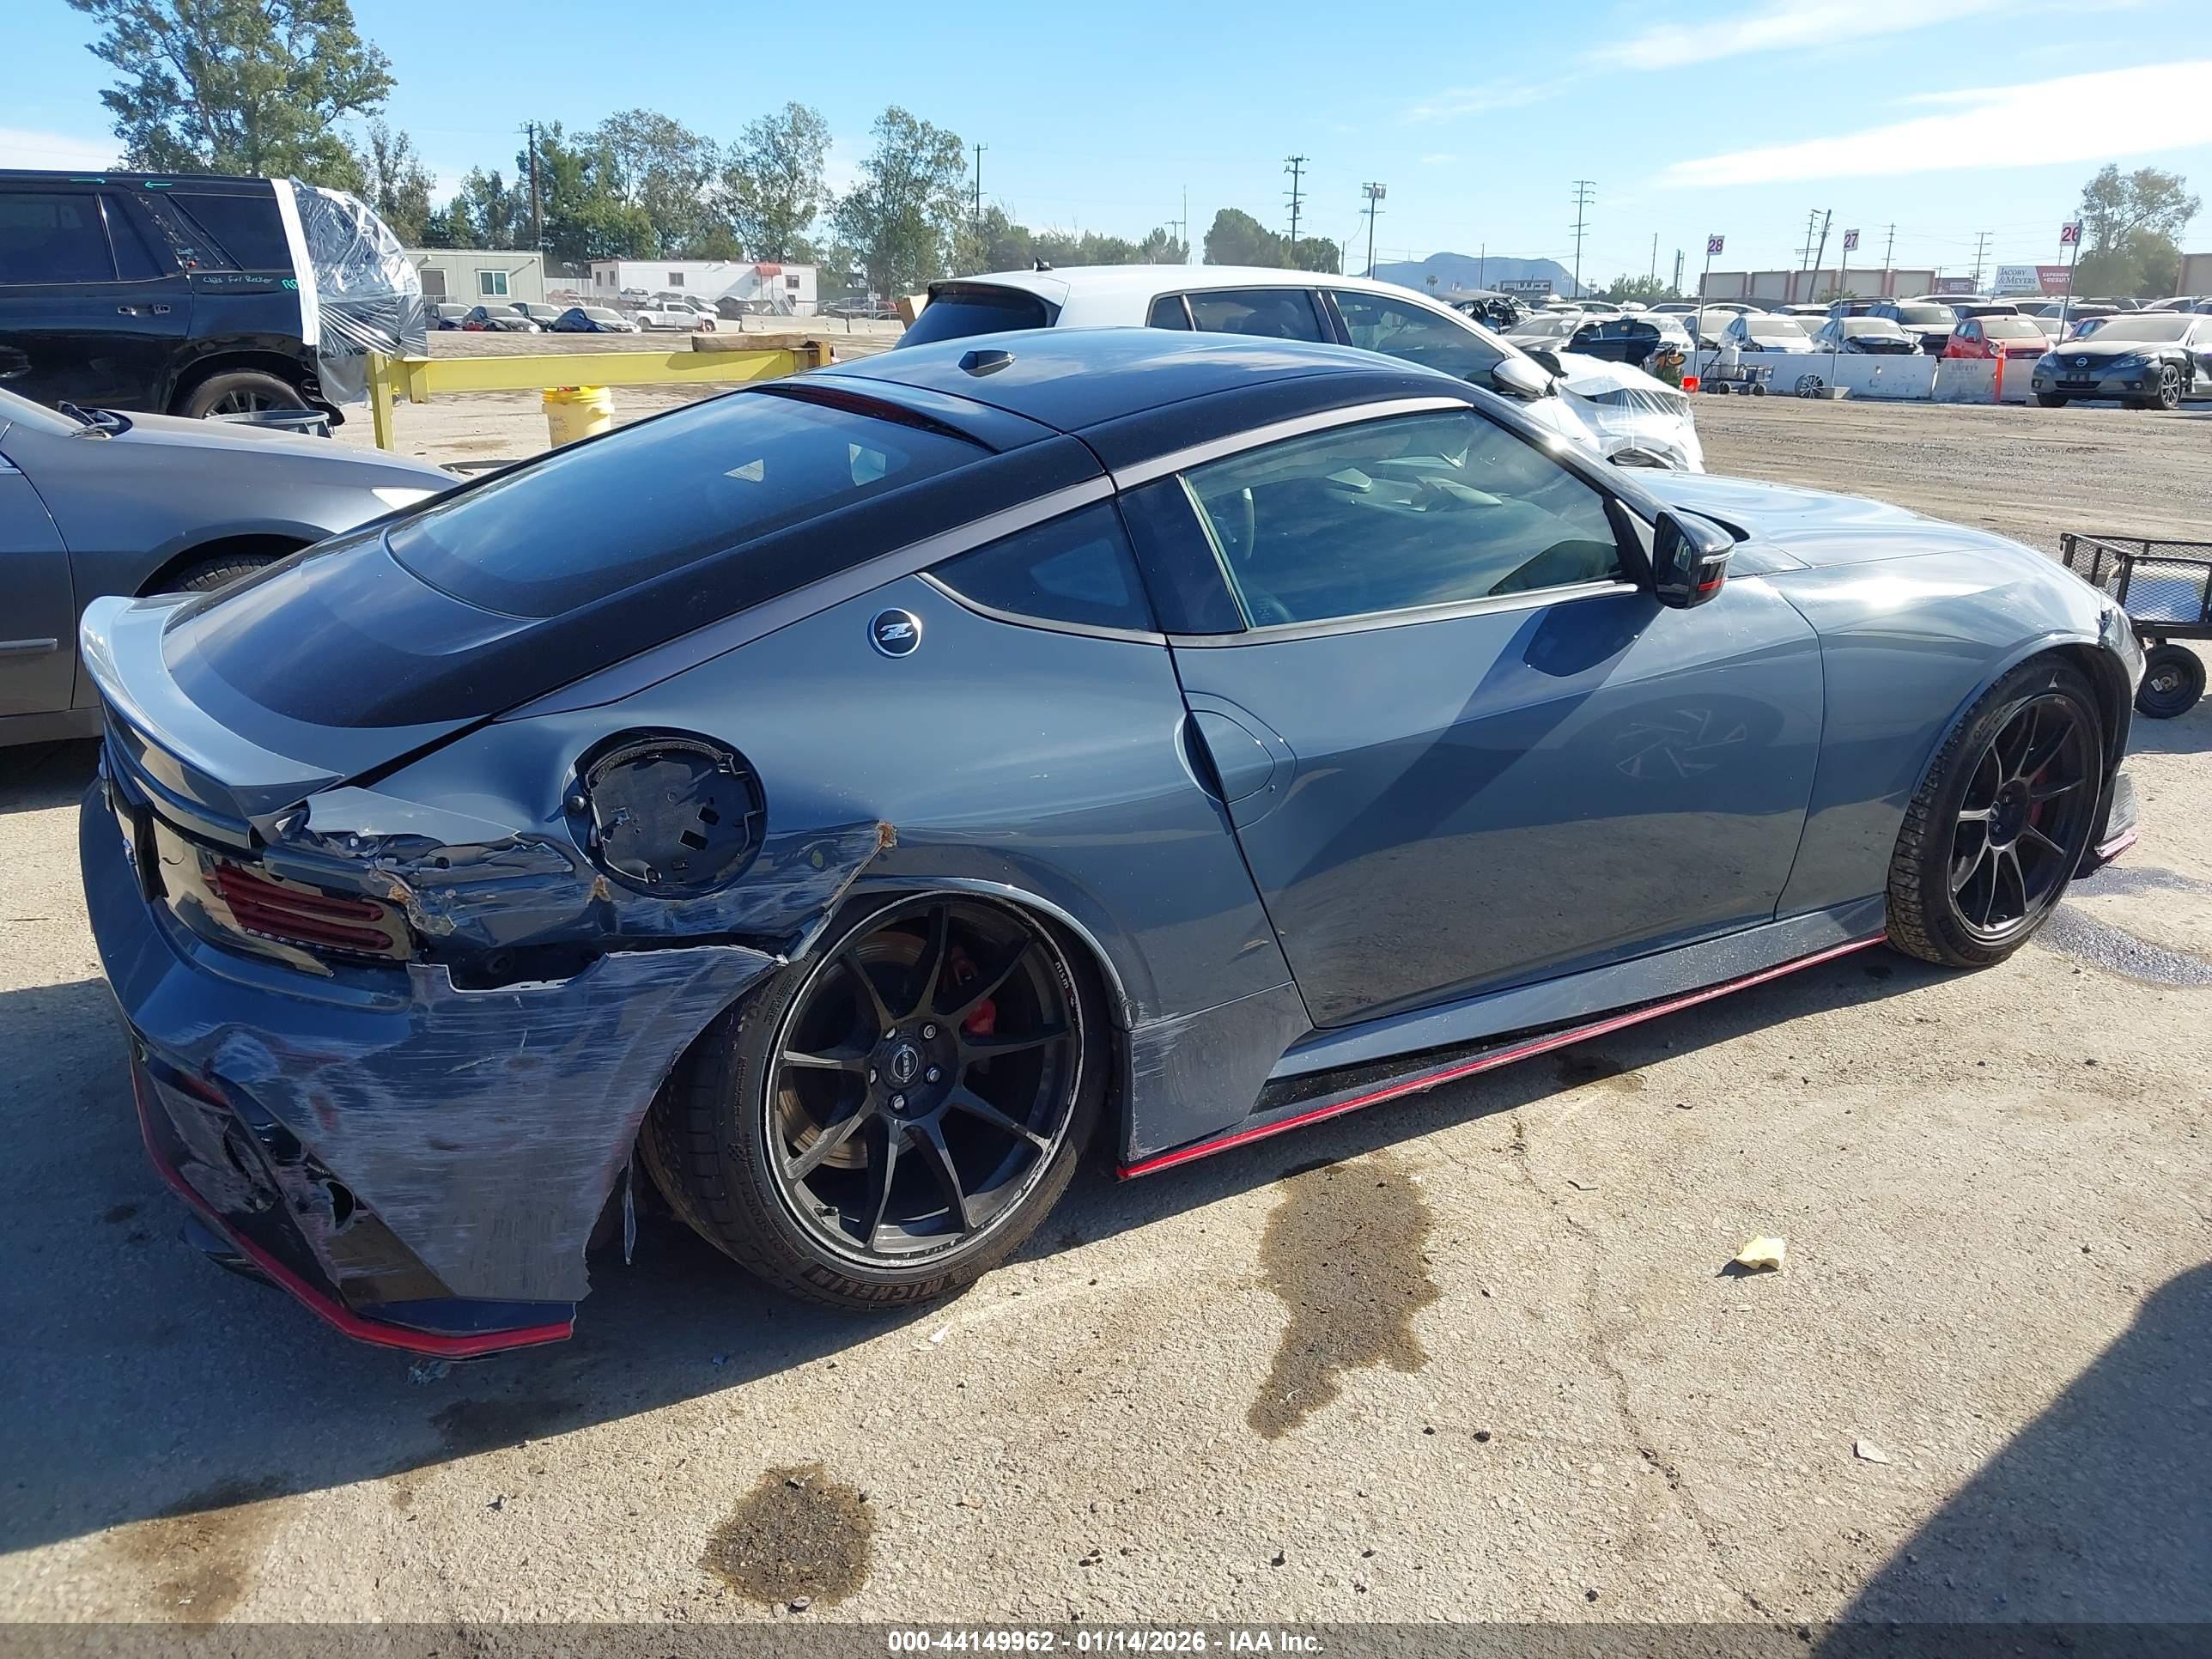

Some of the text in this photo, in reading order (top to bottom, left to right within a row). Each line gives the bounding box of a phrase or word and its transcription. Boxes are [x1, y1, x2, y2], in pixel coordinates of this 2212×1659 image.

[1707, 239, 1723, 252] 28
[1844, 233, 1859, 247] 27
[810, 1268, 945, 1301] MICHELIN
